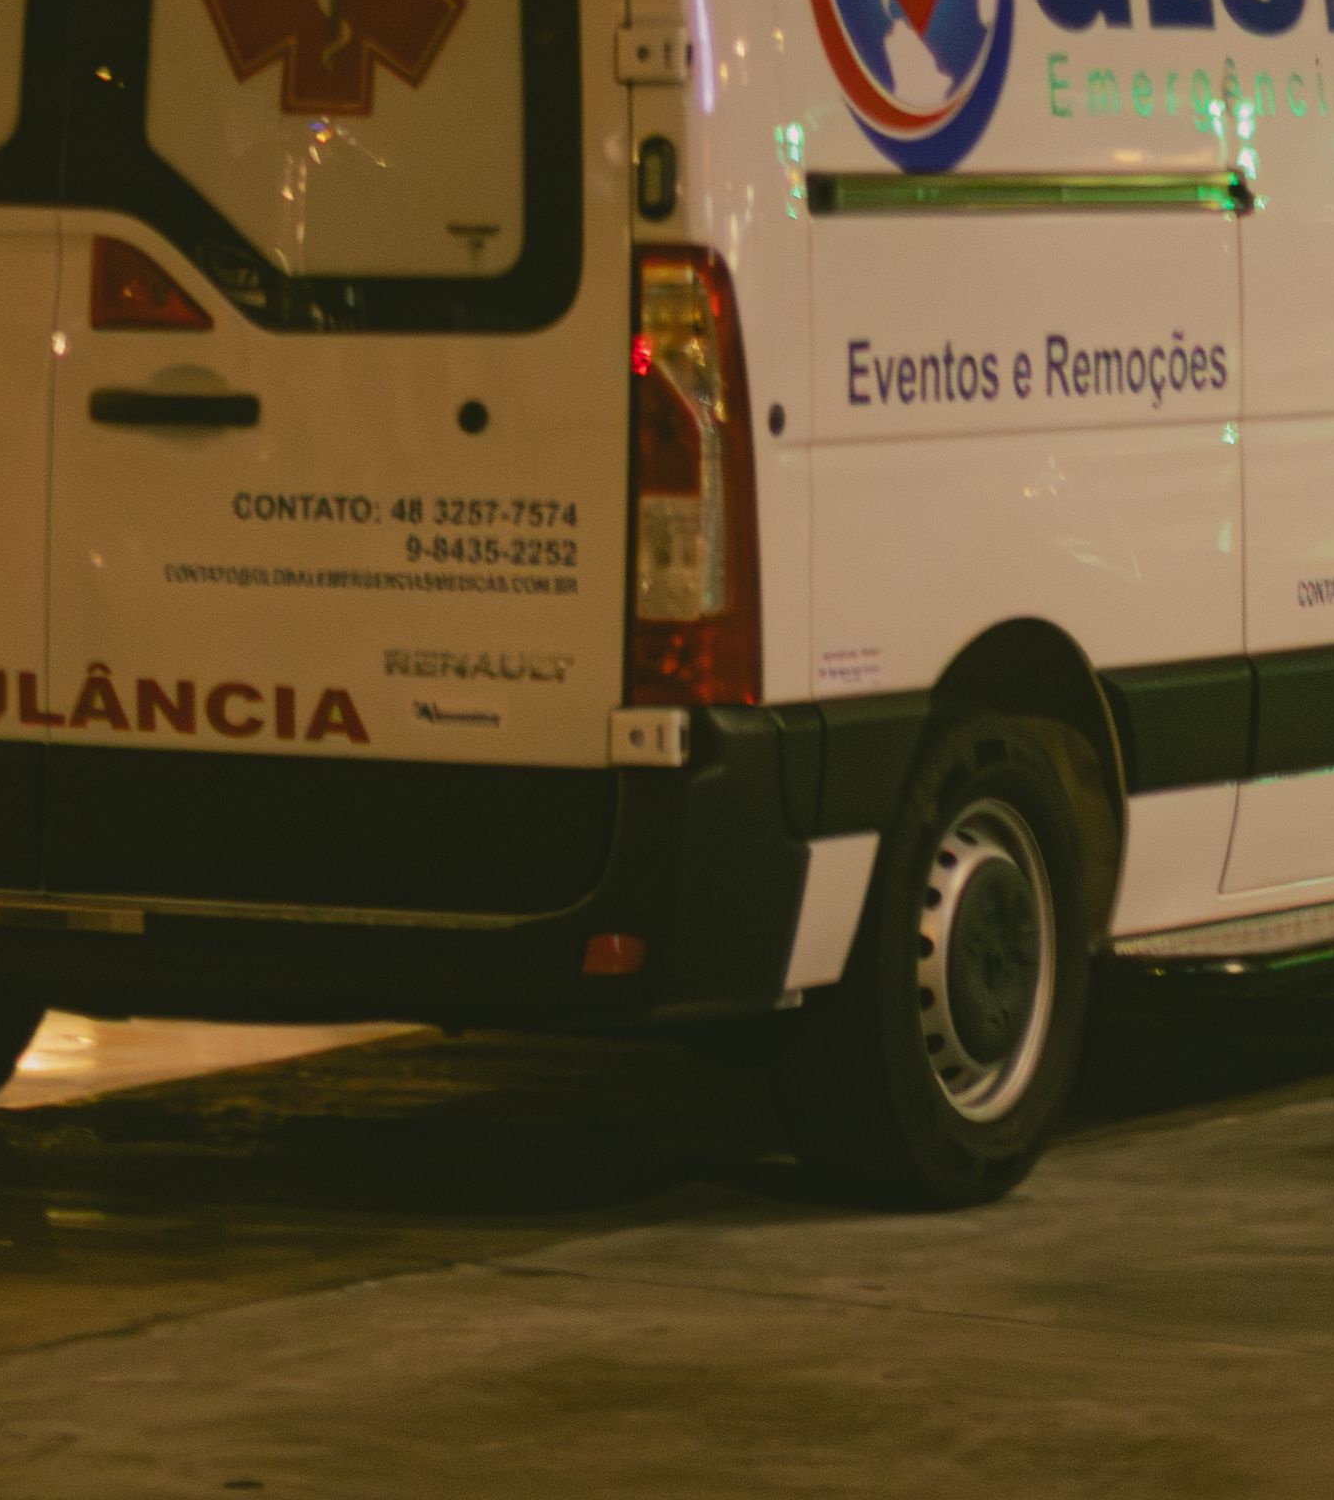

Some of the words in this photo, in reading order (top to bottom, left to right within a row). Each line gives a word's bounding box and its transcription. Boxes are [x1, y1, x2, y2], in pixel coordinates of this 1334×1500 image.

[848, 339, 1000, 404] Eventos
[1013, 350, 1032, 399] e
[1046, 329, 1227, 409] Remoções
[234, 492, 382, 524] CONTATO:
[391, 498, 424, 524] 48
[433, 498, 578, 528] 3257-7574
[406, 534, 578, 567] 9-8435-2252
[383, 649, 574, 682] RENAULT
